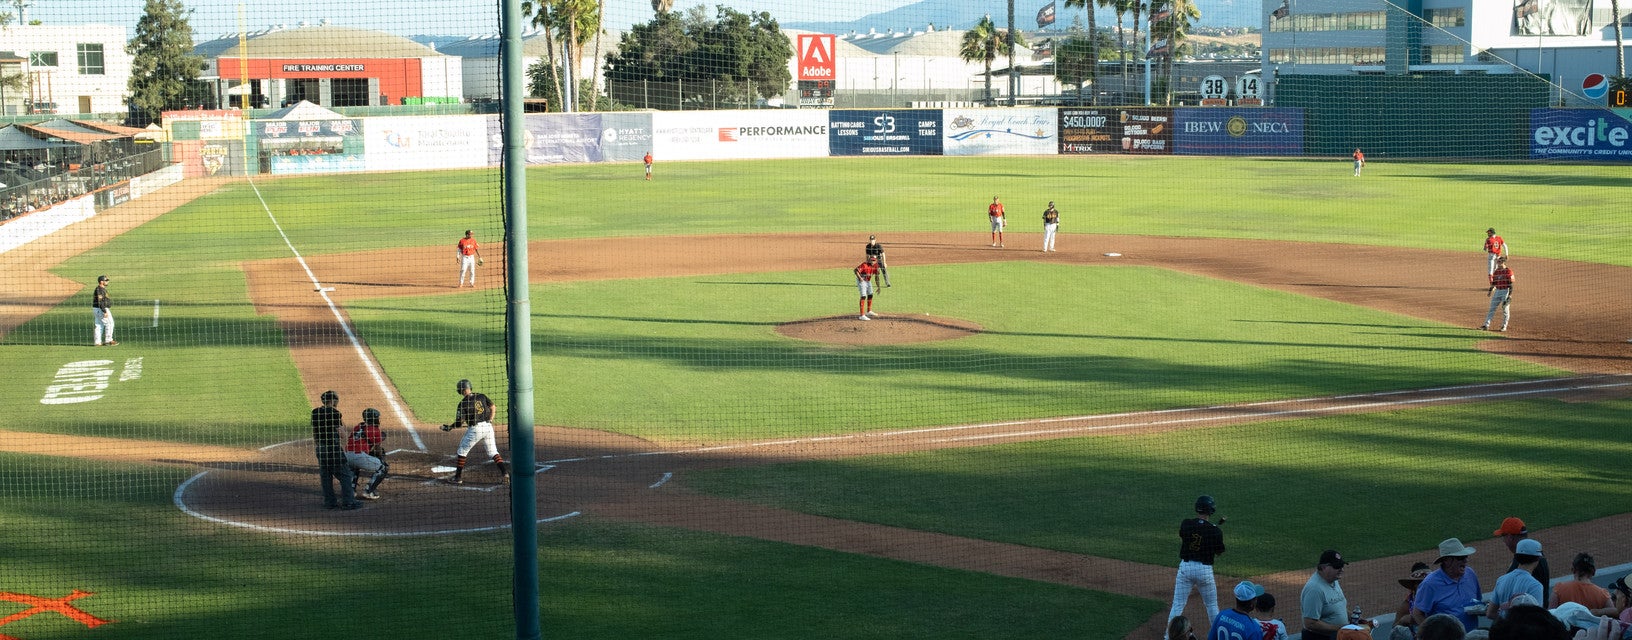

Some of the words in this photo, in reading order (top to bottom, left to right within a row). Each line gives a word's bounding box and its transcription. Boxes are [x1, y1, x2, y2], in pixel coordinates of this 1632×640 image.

[803, 66, 831, 76] Adobe
[1205, 79, 1223, 94] 38
[1242, 79, 1257, 94] 14
[1063, 115, 1106, 128] $450,000?
[1184, 121, 1222, 133] IBEW
[1252, 122, 1290, 133] NECA
[740, 126, 826, 136] PERFORMANCE
[1534, 117, 1629, 147] excite
